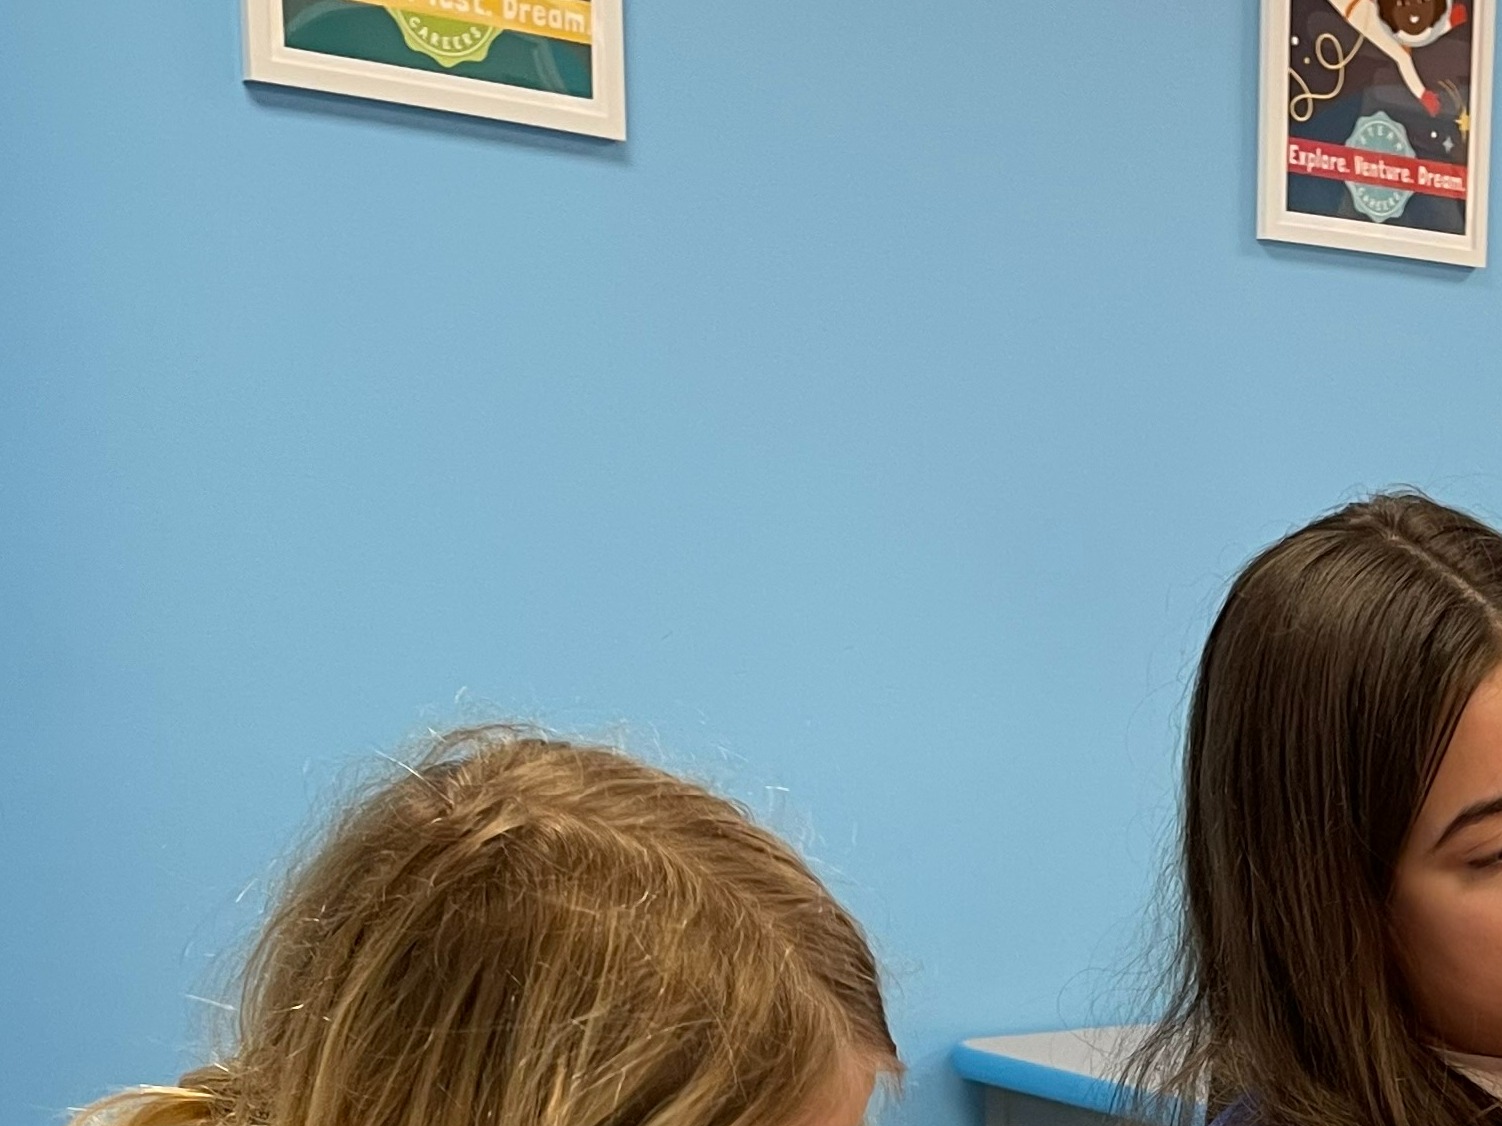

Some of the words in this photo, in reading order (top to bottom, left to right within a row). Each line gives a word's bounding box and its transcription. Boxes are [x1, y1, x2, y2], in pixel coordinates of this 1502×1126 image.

[409, 16, 482, 50] CAREERS
[1288, 144, 1350, 173] Explore.
[1354, 155, 1415, 183] Venture.
[1417, 165, 1466, 192] Dream.
